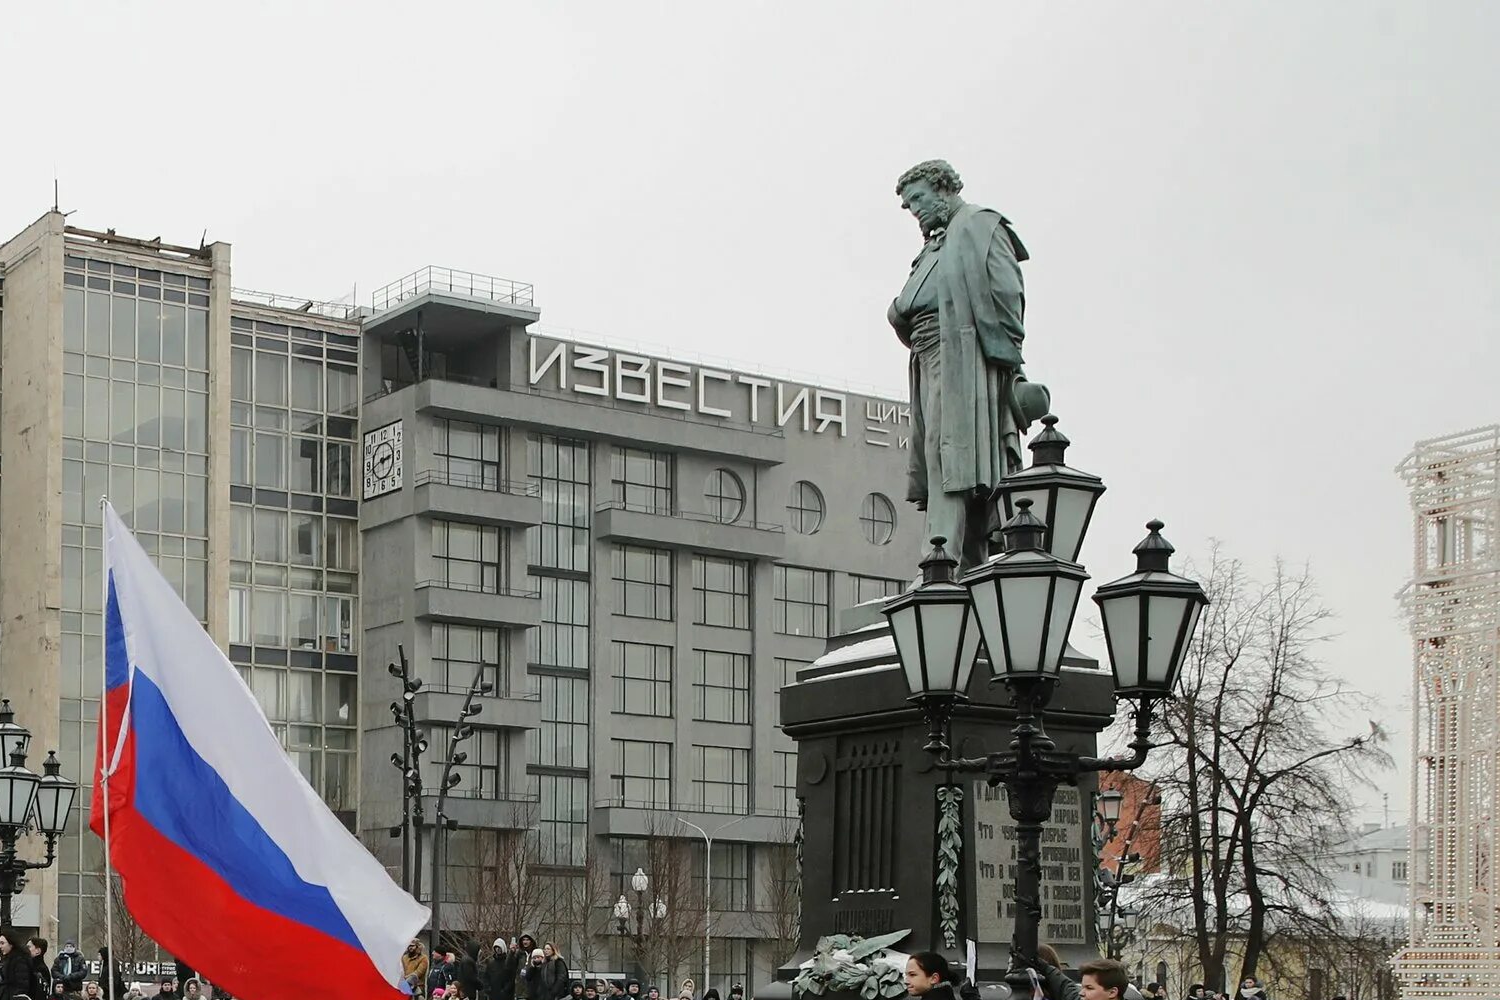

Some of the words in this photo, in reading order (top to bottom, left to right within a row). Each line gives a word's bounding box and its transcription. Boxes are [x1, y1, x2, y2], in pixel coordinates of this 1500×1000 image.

[528, 337, 848, 437] ИЗВЕСТИЯ
[370, 433, 376, 445] 11
[380, 429, 388, 441] 12
[365, 444, 372, 456] 10
[1008, 865, 1018, 880] МО
